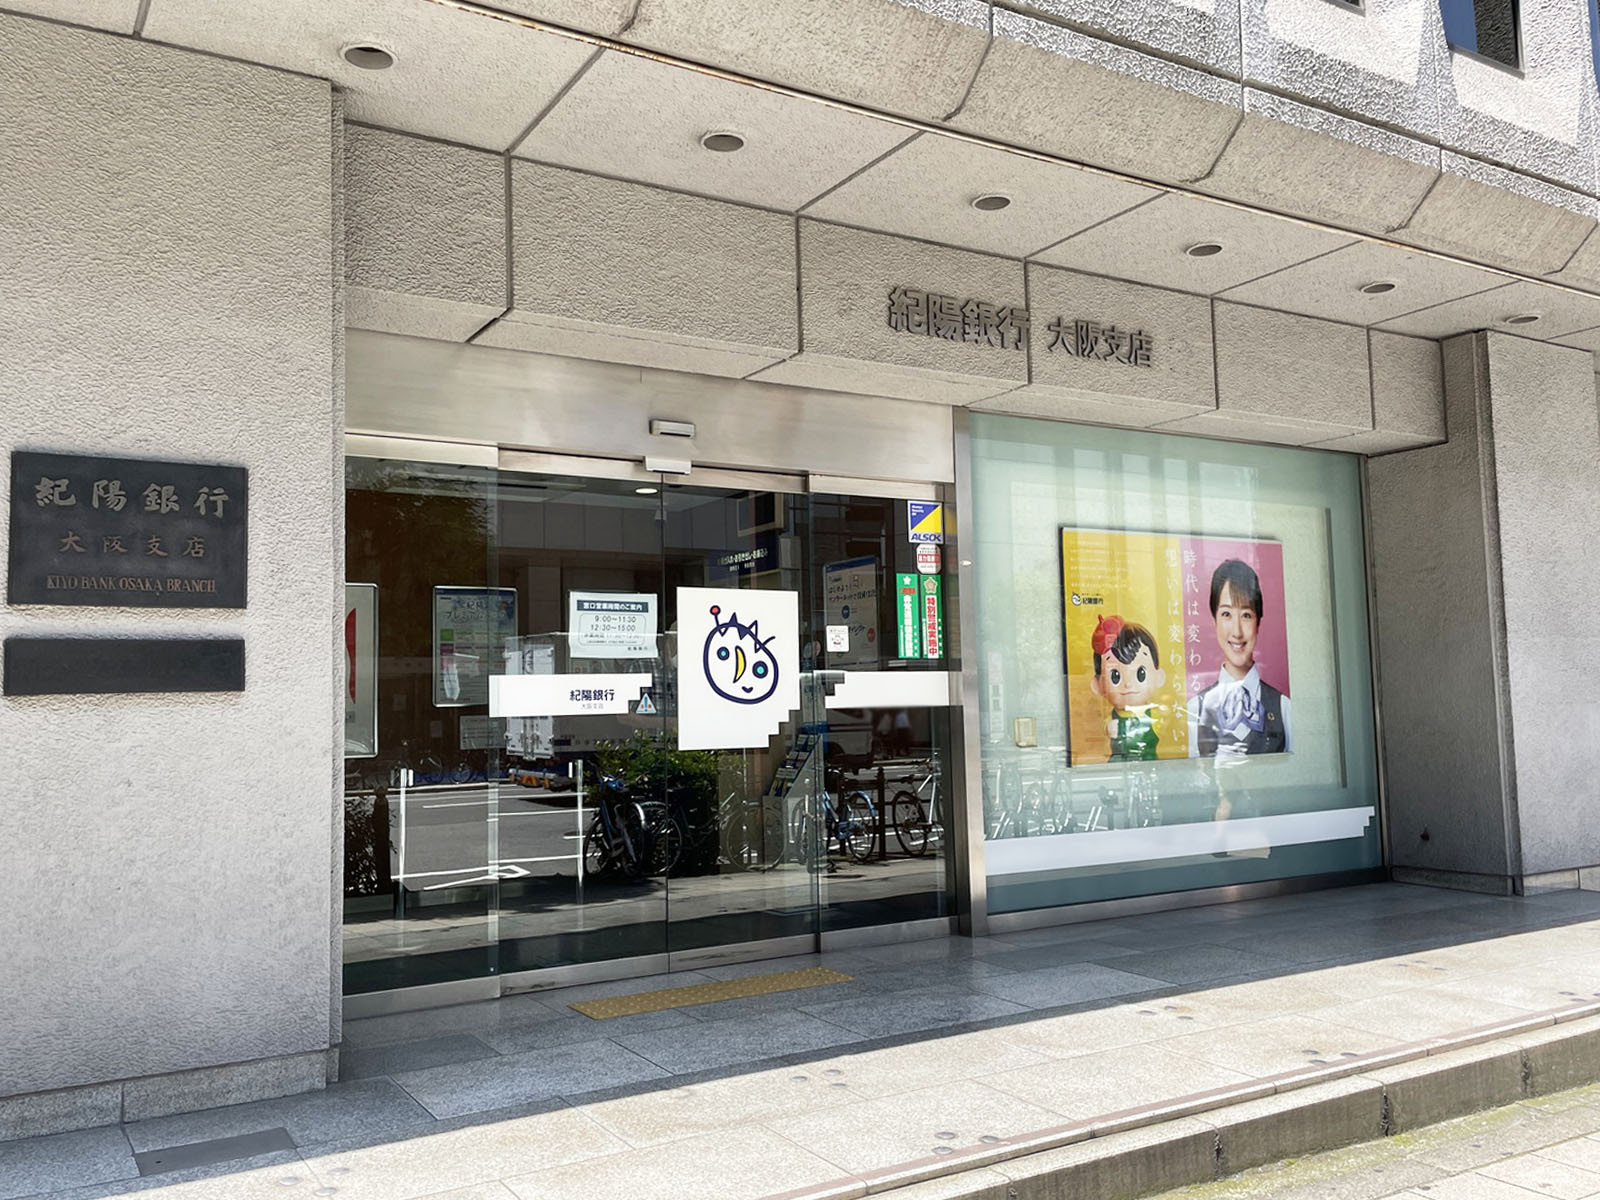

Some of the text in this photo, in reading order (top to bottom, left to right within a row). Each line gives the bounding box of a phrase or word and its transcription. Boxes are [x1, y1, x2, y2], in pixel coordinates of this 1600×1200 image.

[888, 286, 1153, 367] 紀陽銀行 大阪支店
[34, 476, 229, 518] 紀陽銀行
[60, 531, 206, 558] 大阪支店
[911, 533, 942, 542] ALSOK
[47, 575, 216, 593] KIYO BANK OSAKA BRANCH
[569, 688, 615, 702] 紀陽銀行
